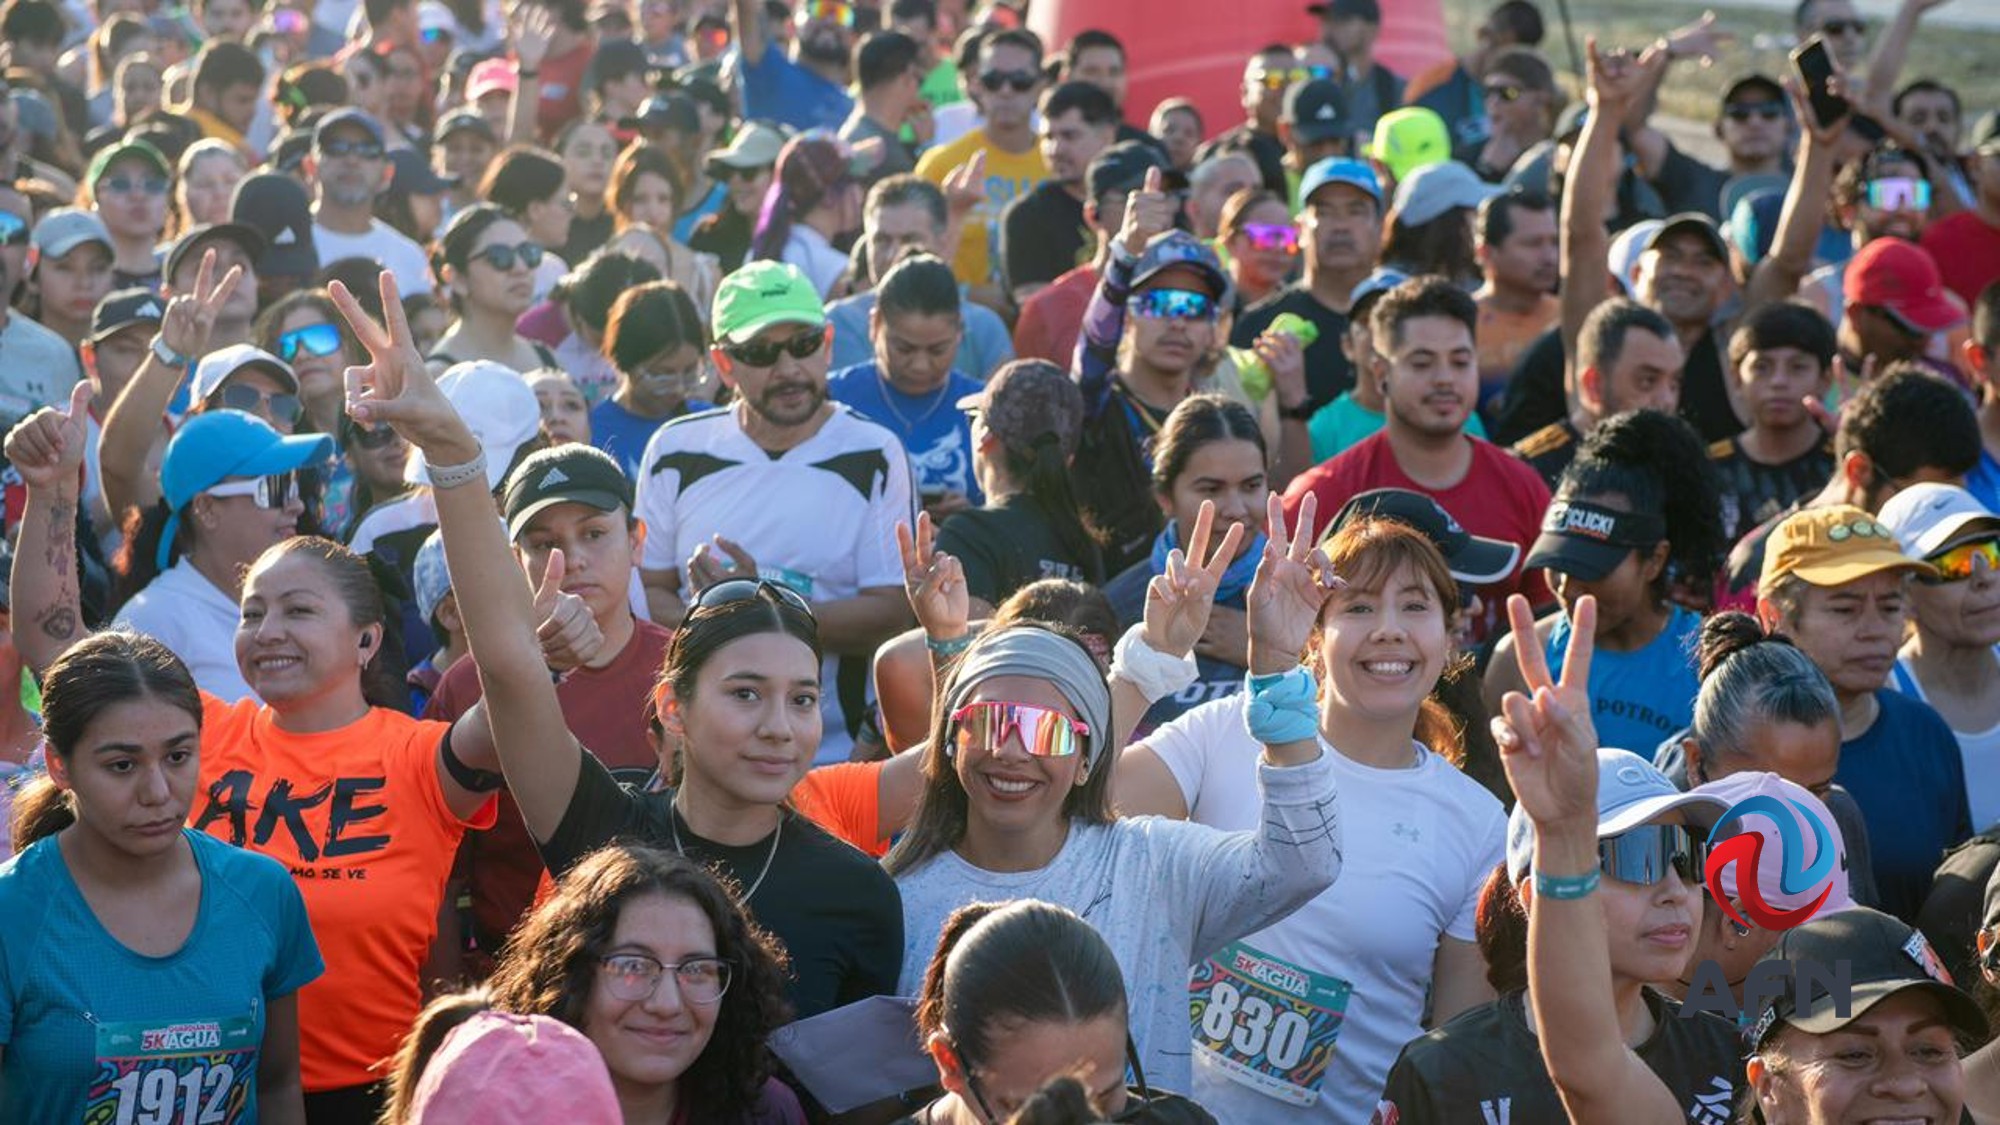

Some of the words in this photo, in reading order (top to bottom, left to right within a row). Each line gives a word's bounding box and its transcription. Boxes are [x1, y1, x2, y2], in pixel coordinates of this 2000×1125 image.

[193, 770, 391, 863] AKE
[322, 868, 341, 879] SE
[347, 868, 366, 879] VE
[1257, 964, 1310, 997] AGUA
[142, 1033, 166, 1050] 5K
[166, 1031, 219, 1049] AGUA
[1202, 981, 1310, 1070] 830
[112, 1063, 234, 1125] 1912
